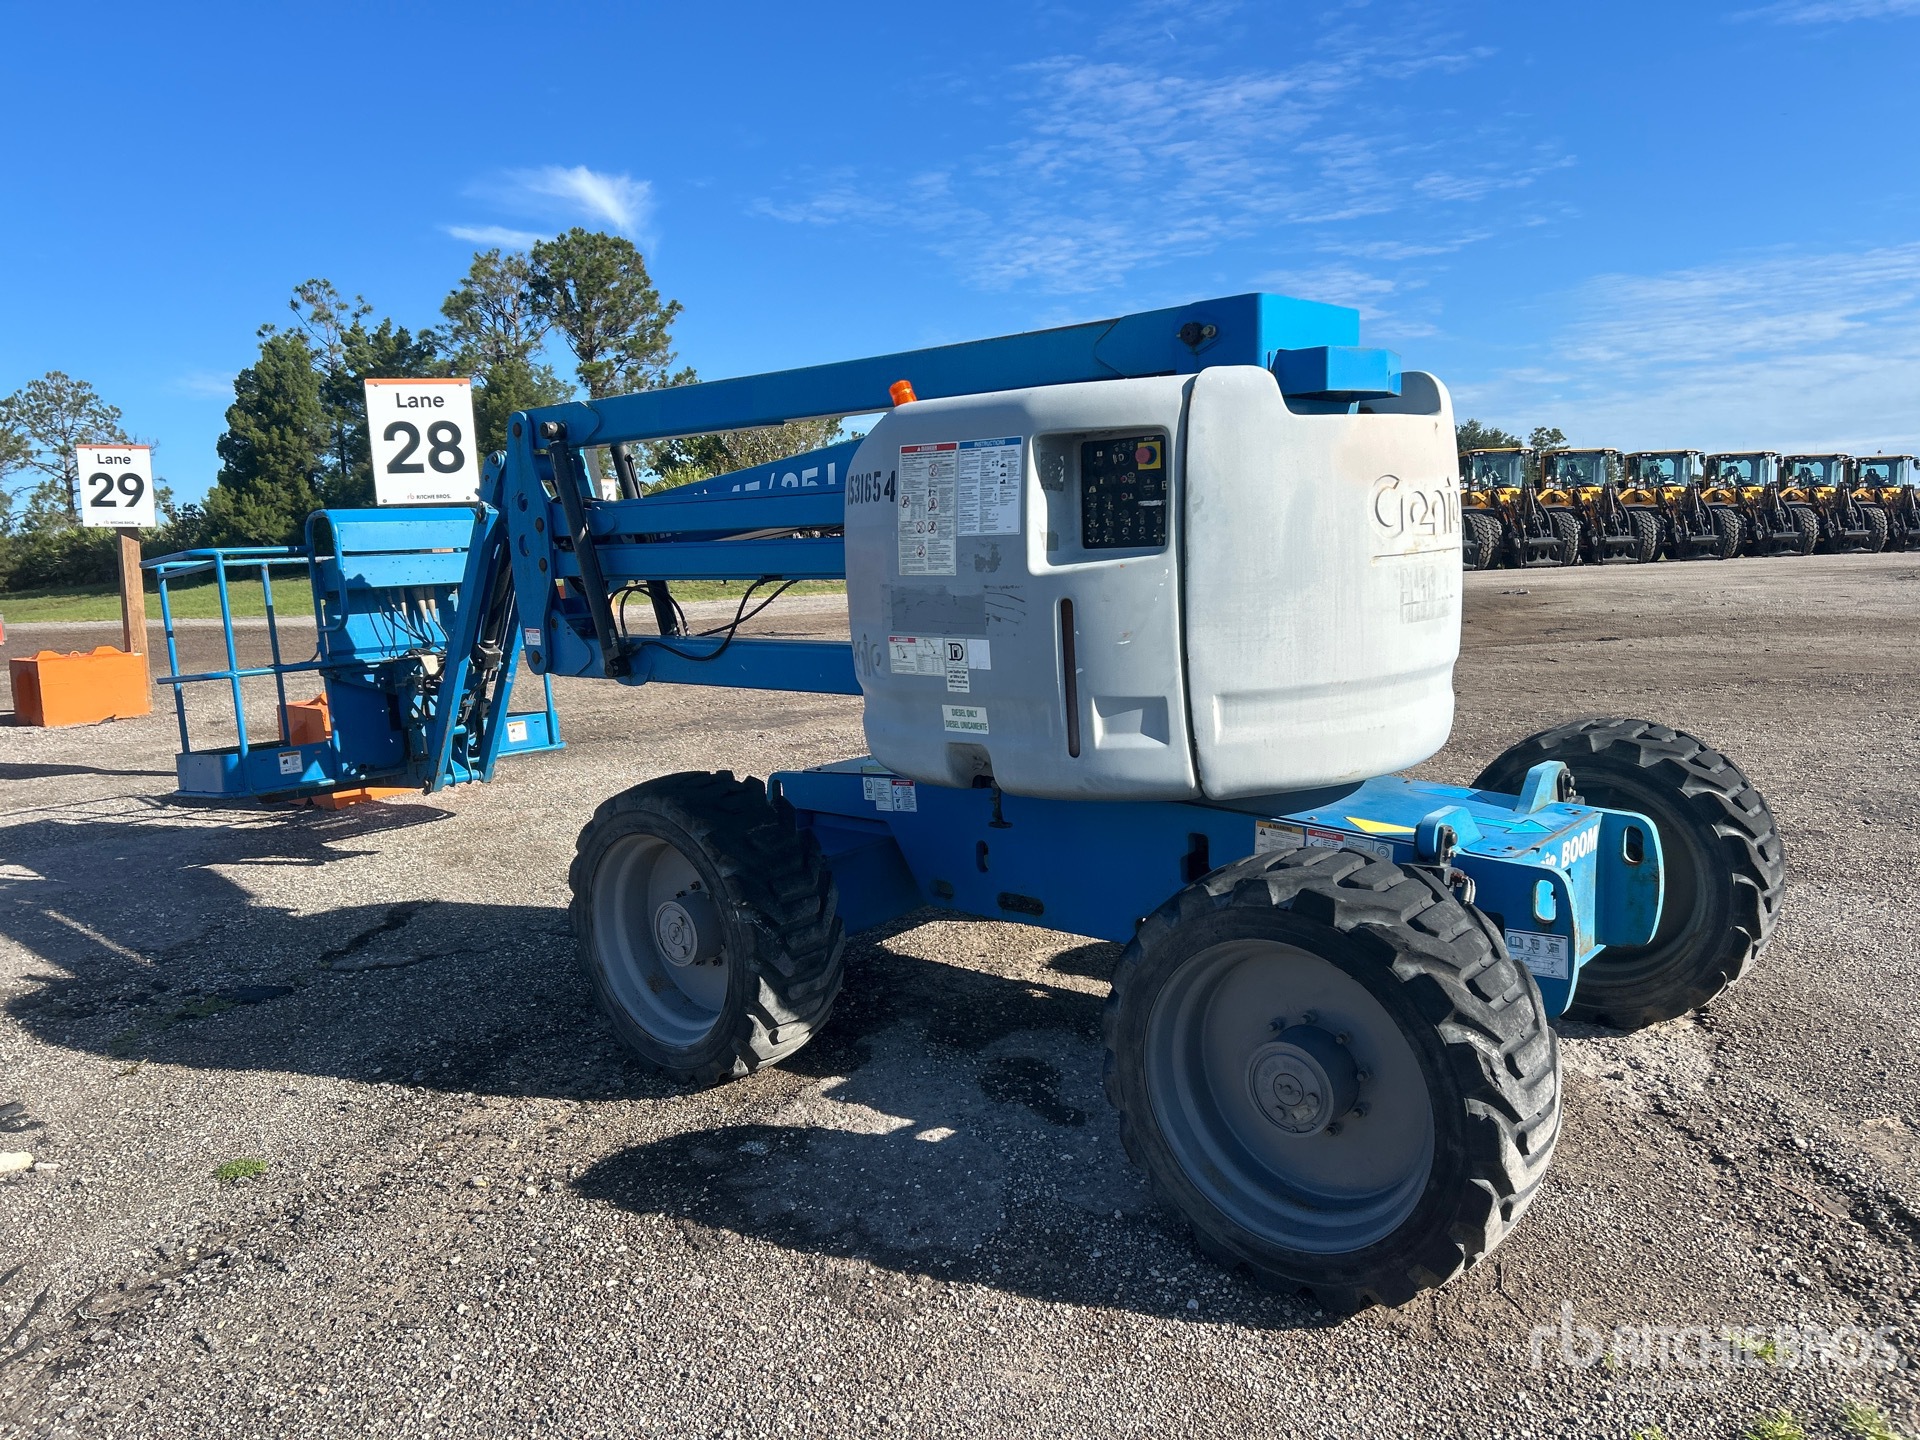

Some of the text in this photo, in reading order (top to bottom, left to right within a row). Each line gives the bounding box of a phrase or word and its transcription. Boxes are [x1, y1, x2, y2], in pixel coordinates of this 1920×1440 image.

[396, 392, 444, 408] Lane
[383, 420, 465, 474] 28
[974, 438, 1006, 447] INSTRUCTIONS
[97, 453, 131, 465] Lane
[88, 472, 145, 507] 29
[951, 708, 977, 718] DIESEL ONLY
[945, 720, 988, 731] DIESEL UNICAMENTE
[1561, 824, 1599, 869] BOOM
